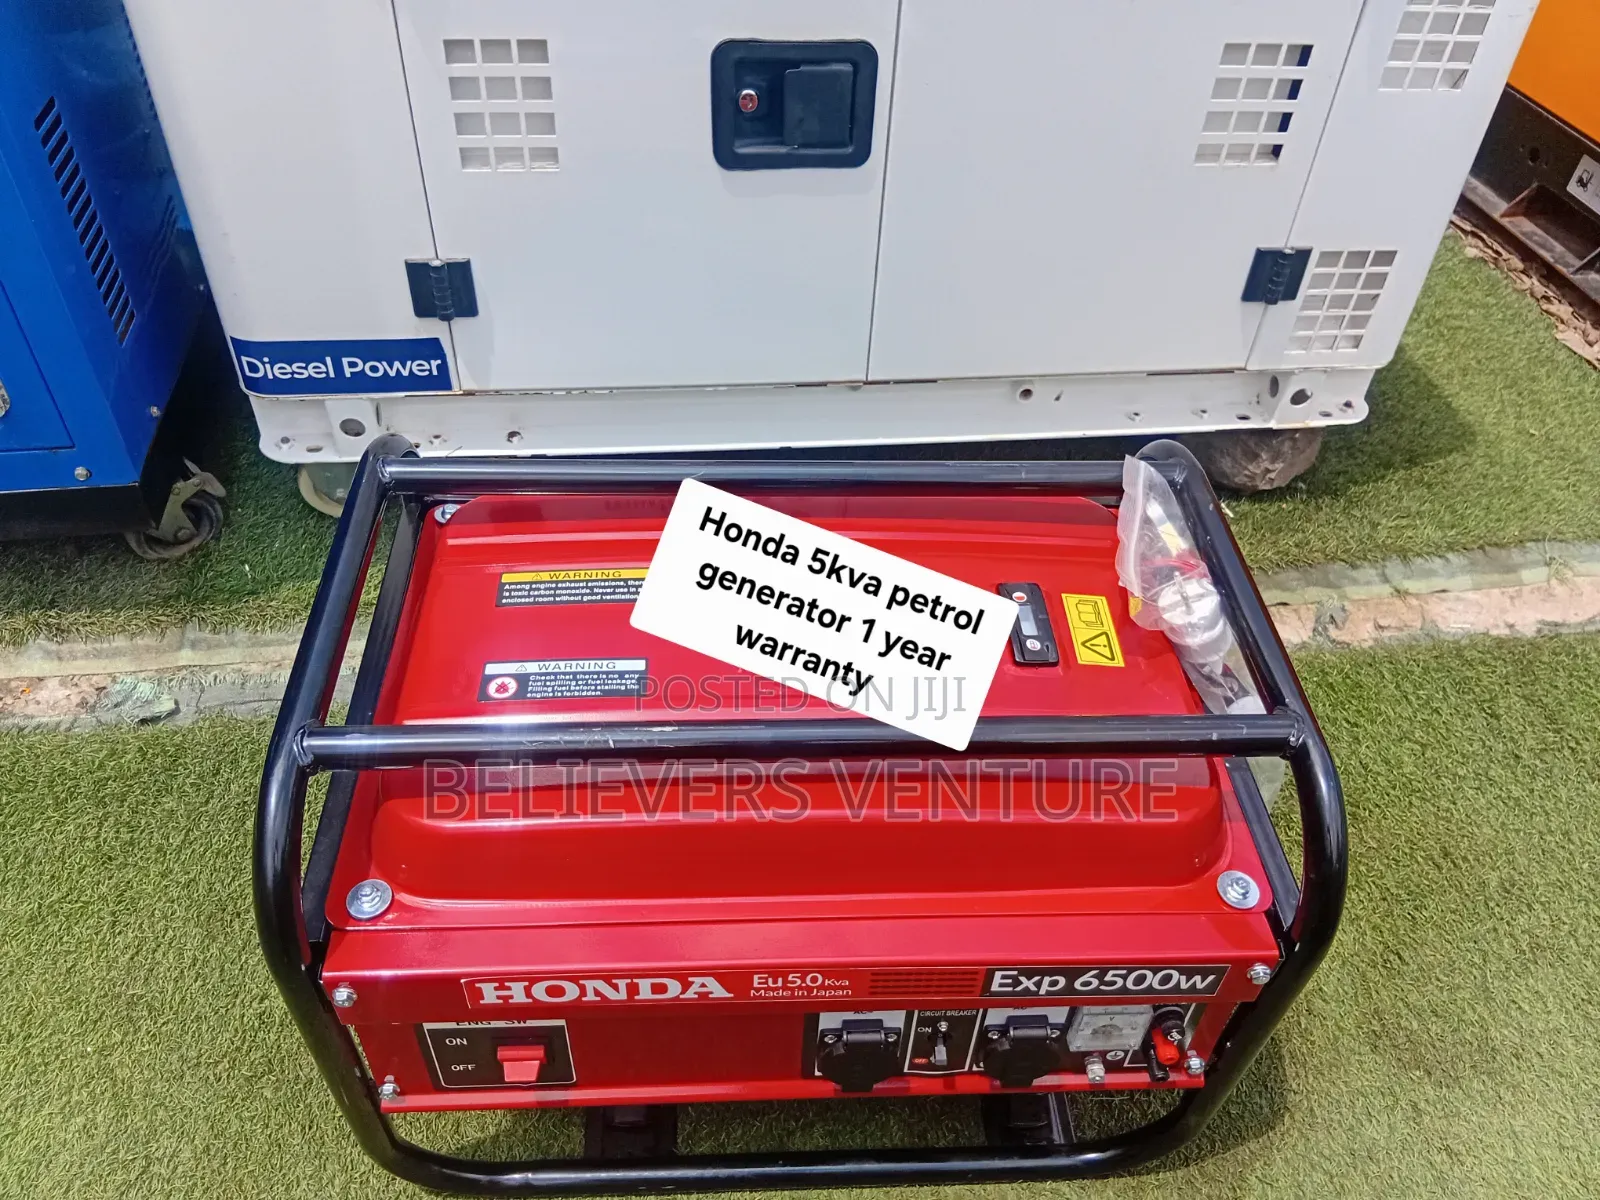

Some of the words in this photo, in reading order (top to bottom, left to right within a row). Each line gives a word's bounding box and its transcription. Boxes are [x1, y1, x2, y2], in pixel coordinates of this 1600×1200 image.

[240, 355, 335, 379] Diesel
[341, 357, 442, 378] Power
[549, 570, 622, 580] WARNING
[537, 661, 616, 671] WARNING
[990, 970, 1067, 995] Exp
[1073, 969, 1217, 992] 6500w
[474, 976, 734, 1004] HONDA
[753, 974, 783, 988] Eu
[787, 973, 823, 987] 5.0
[824, 978, 849, 986] Kva
[750, 989, 791, 997] Made
[810, 988, 852, 997] Japan
[445, 1037, 468, 1046] ON
[451, 1064, 476, 1072] OFF
